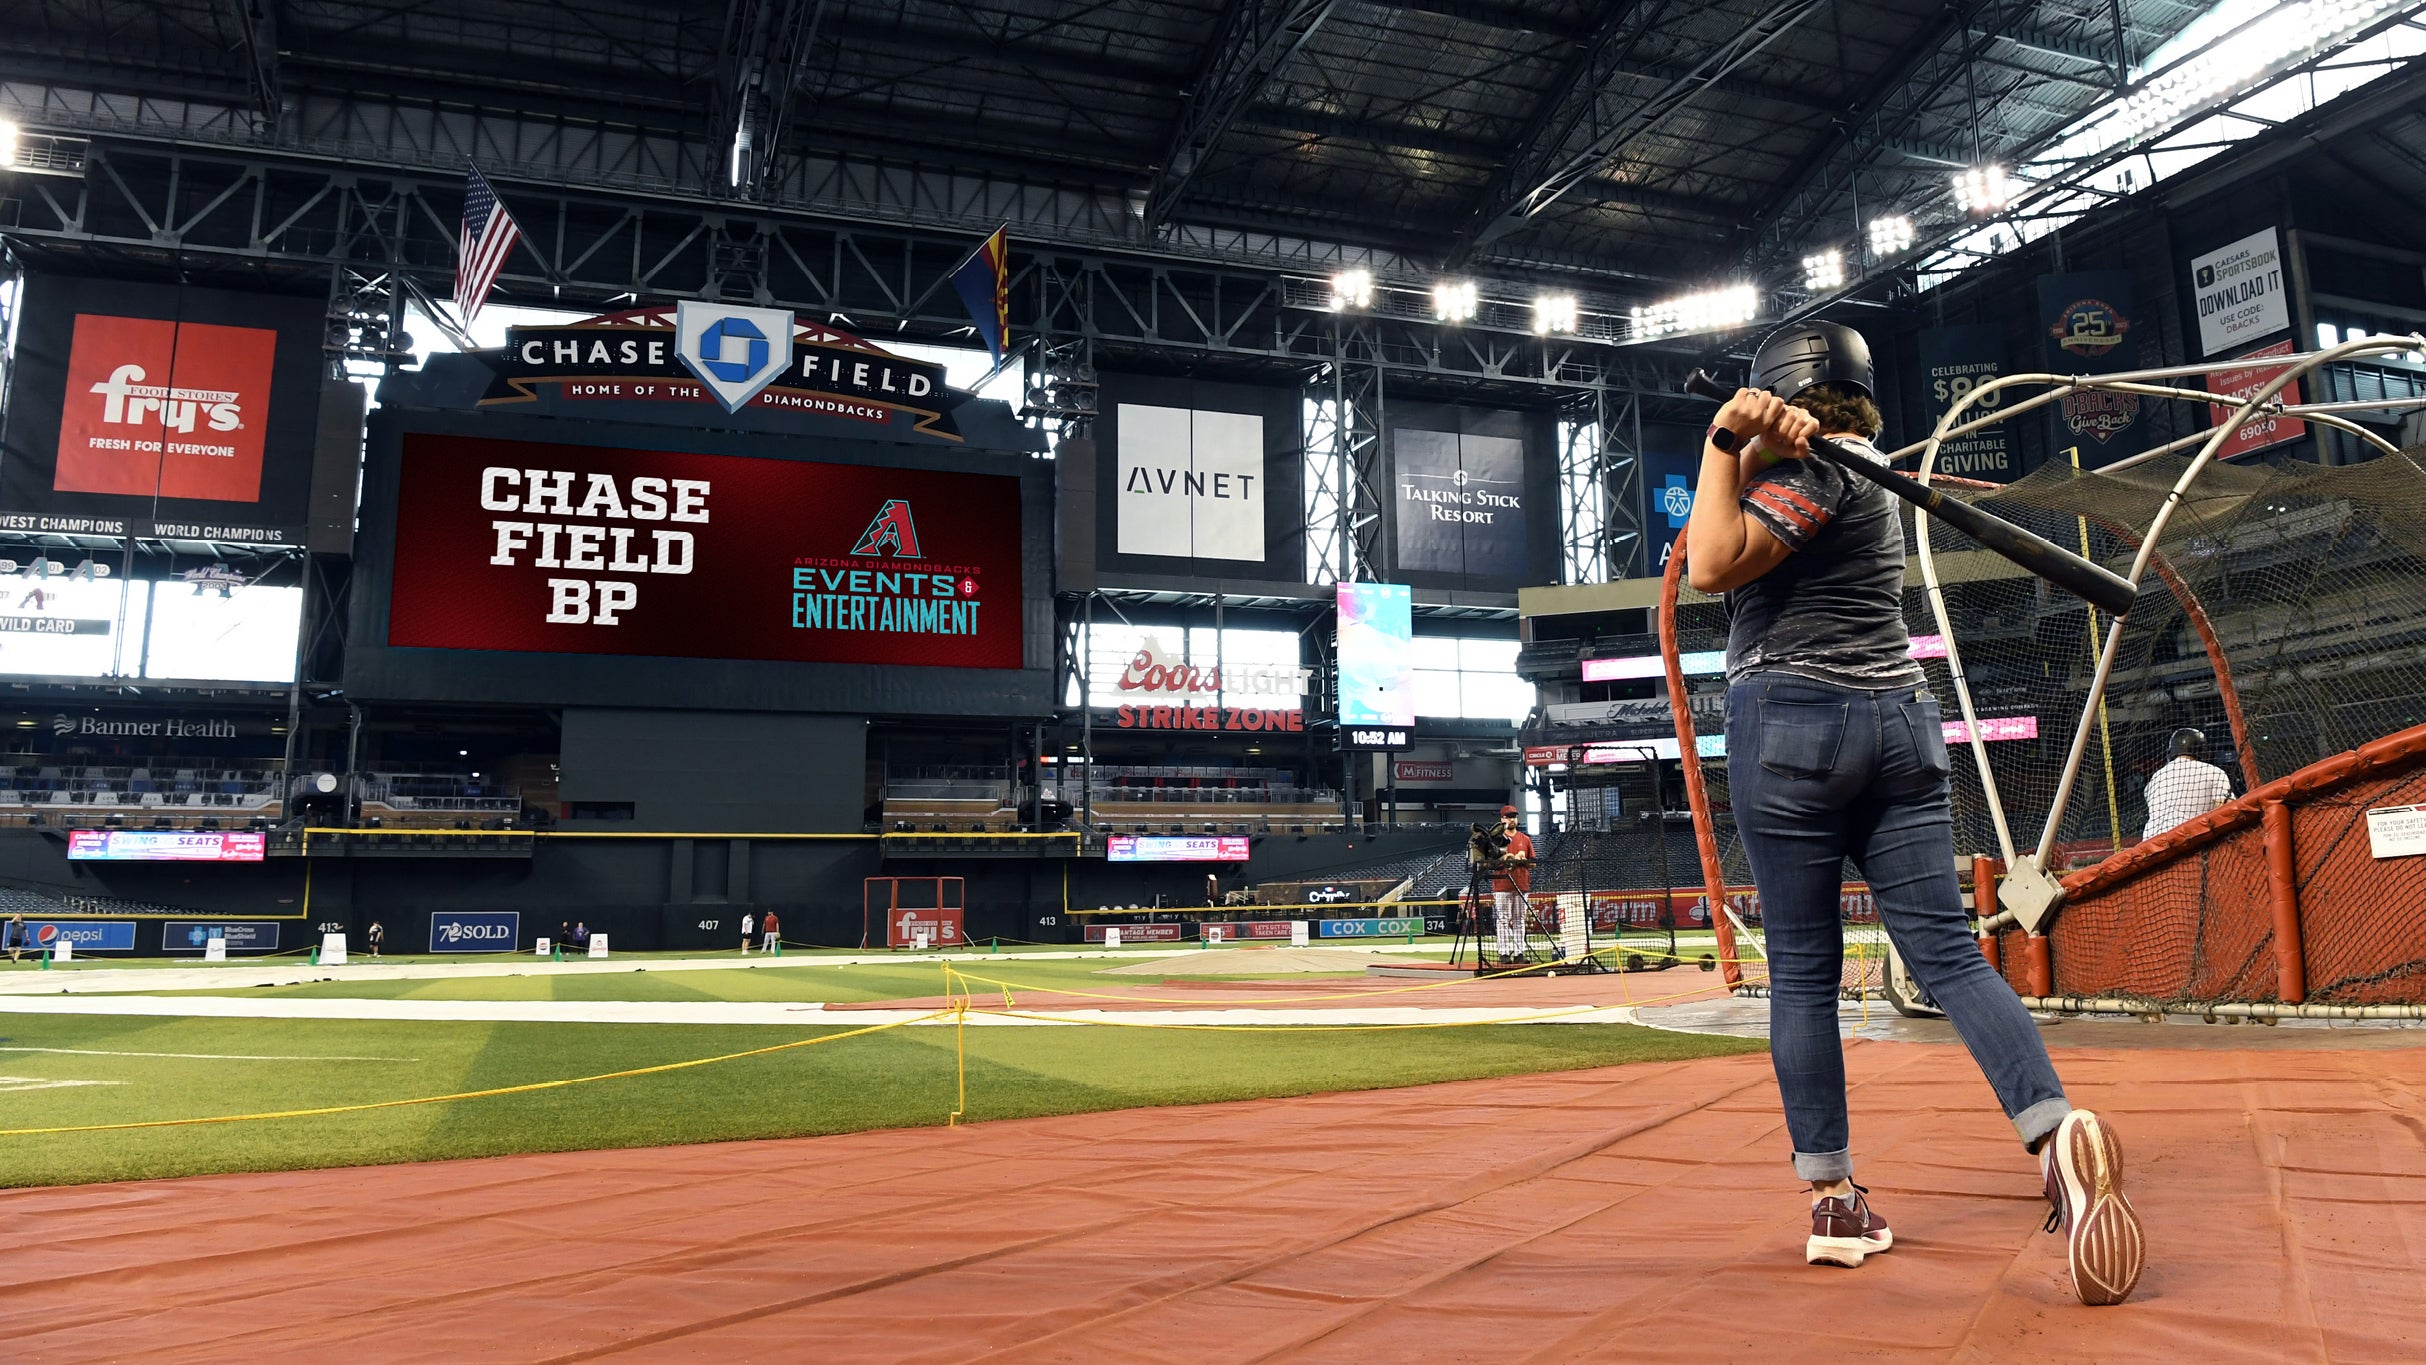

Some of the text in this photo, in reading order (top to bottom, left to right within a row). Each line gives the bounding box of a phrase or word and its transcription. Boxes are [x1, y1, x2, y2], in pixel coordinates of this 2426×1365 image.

[2215, 250, 2250, 269] CAESARS
[2216, 249, 2277, 281] SPORTSBOOK
[2200, 270, 2279, 317] DOWNLOAD IT
[2072, 311, 2106, 336] 25
[2220, 304, 2264, 325] USE CODE:
[2226, 315, 2260, 334] DBACKS
[521, 340, 931, 397] CHASE FIELD
[1931, 362, 1998, 377] CELEBRATING
[89, 364, 241, 433] fry's
[130, 386, 233, 401] FOOD STORES
[572, 385, 884, 419] HOME OF THE DIAMONDBACKS
[2070, 411, 2131, 433] Give Back
[89, 438, 235, 457] FRESH FOR EVERYONE
[1940, 439, 2006, 454] CHARITABLE
[1941, 452, 2008, 474] GIVING
[1127, 467, 1254, 500] AVNET
[481, 466, 710, 523] CHASE
[40, 517, 123, 533] CHAMPIONS
[154, 523, 283, 541] WORLD CHAMPIONS
[490, 521, 694, 574] FIELD
[794, 557, 981, 574] ARIZONA DIAMONDBACKS
[793, 568, 954, 597] EVENTS
[546, 578, 637, 626] BP
[792, 593, 980, 635] ENTERTAINMENT
[35, 619, 75, 632] CARD
[1118, 650, 1314, 696] Coors LIGHT
[1117, 704, 1304, 731] STRIKE ZONE
[1607, 700, 1671, 718] Michelob
[80, 716, 237, 738] Banner Health
[1352, 731, 1406, 745] 10:52 AM
[1416, 769, 1452, 778] FITNESS
[112, 837, 158, 845] SWING
[177, 837, 220, 846] SEATS
[318, 923, 338, 933] 413
[698, 920, 719, 930] 407
[896, 912, 955, 941] frys
[1039, 916, 1056, 926] 413
[1332, 921, 1411, 934] COX COX
[1426, 921, 1446, 930] 374
[61, 928, 103, 943] pepsi
